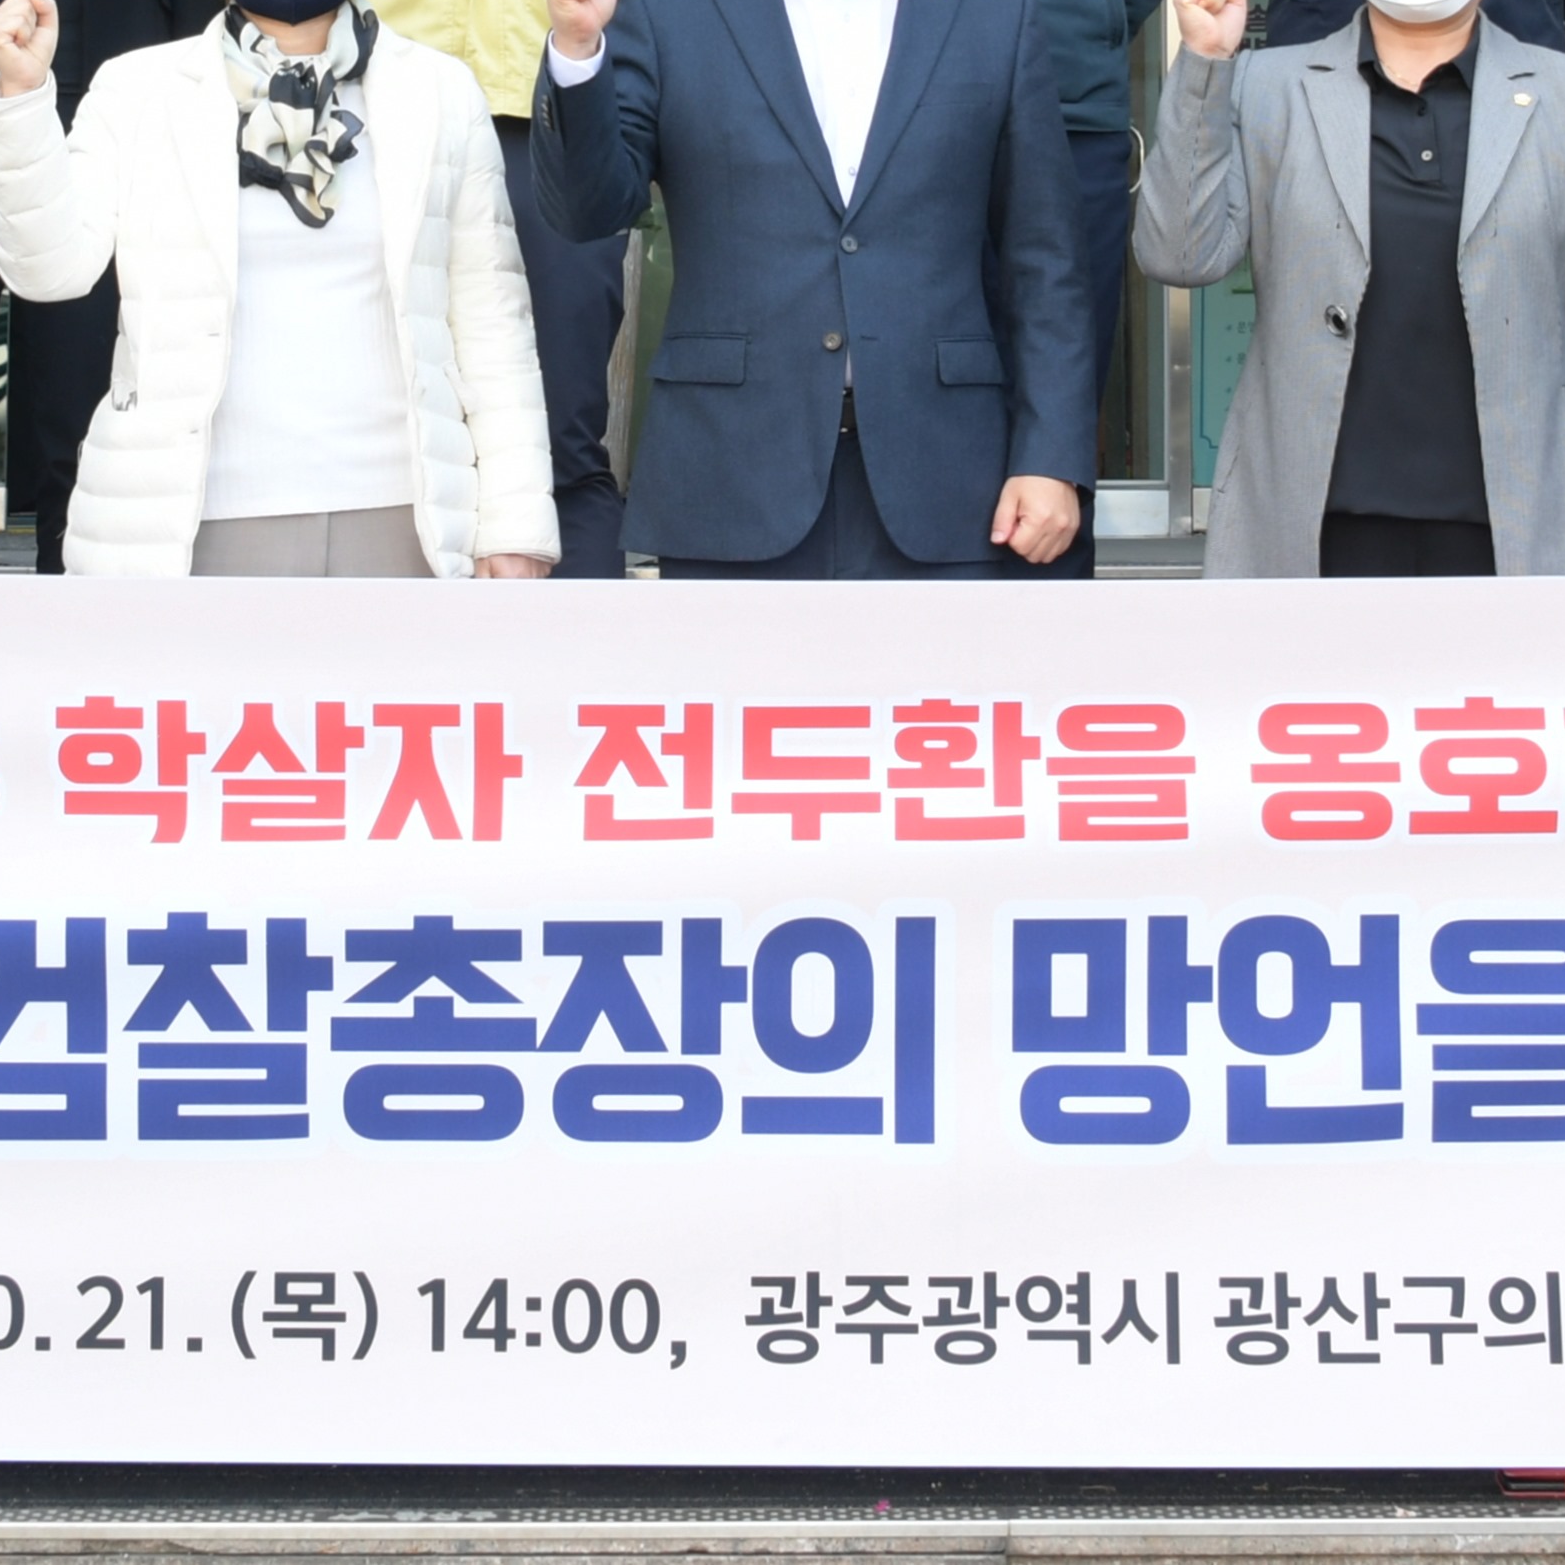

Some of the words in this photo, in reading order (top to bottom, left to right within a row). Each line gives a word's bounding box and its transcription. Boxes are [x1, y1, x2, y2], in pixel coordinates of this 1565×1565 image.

[56, 695, 524, 843] 학살자
[574, 695, 1195, 843] 전두환을
[418, 1278, 686, 1369] 14:00,
[744, 1270, 1182, 1365] 광주광역시
